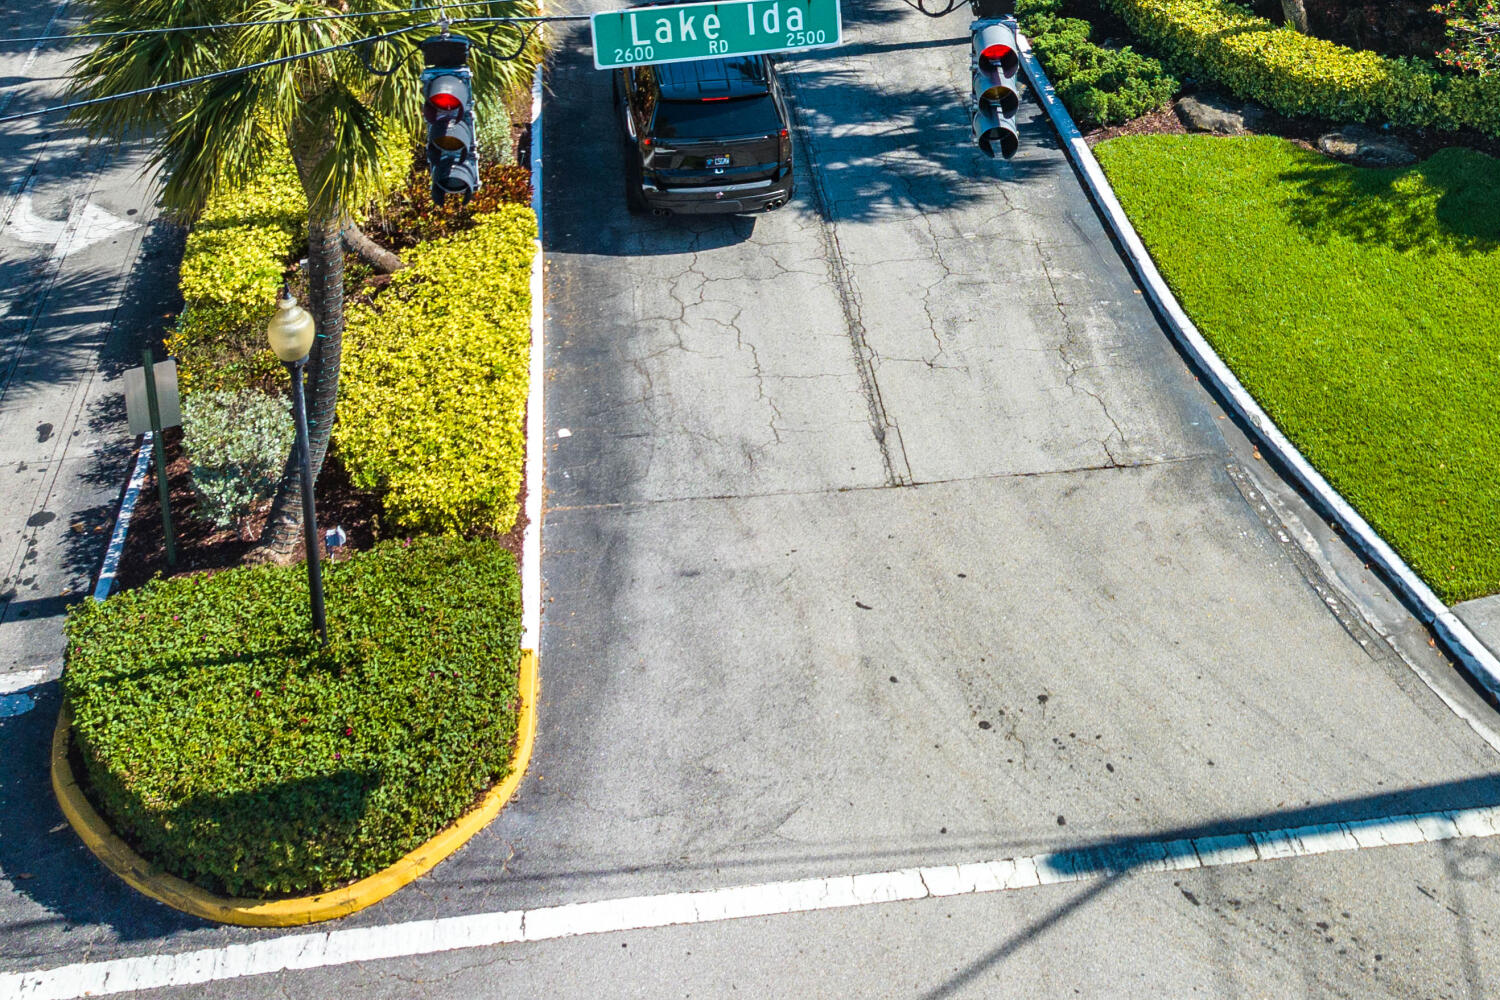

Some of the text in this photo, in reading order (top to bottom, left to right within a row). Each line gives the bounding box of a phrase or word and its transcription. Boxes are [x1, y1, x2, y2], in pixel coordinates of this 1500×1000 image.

[630, 2, 804, 46] Lake Ida
[614, 30, 825, 63] 2600 RD 2500
